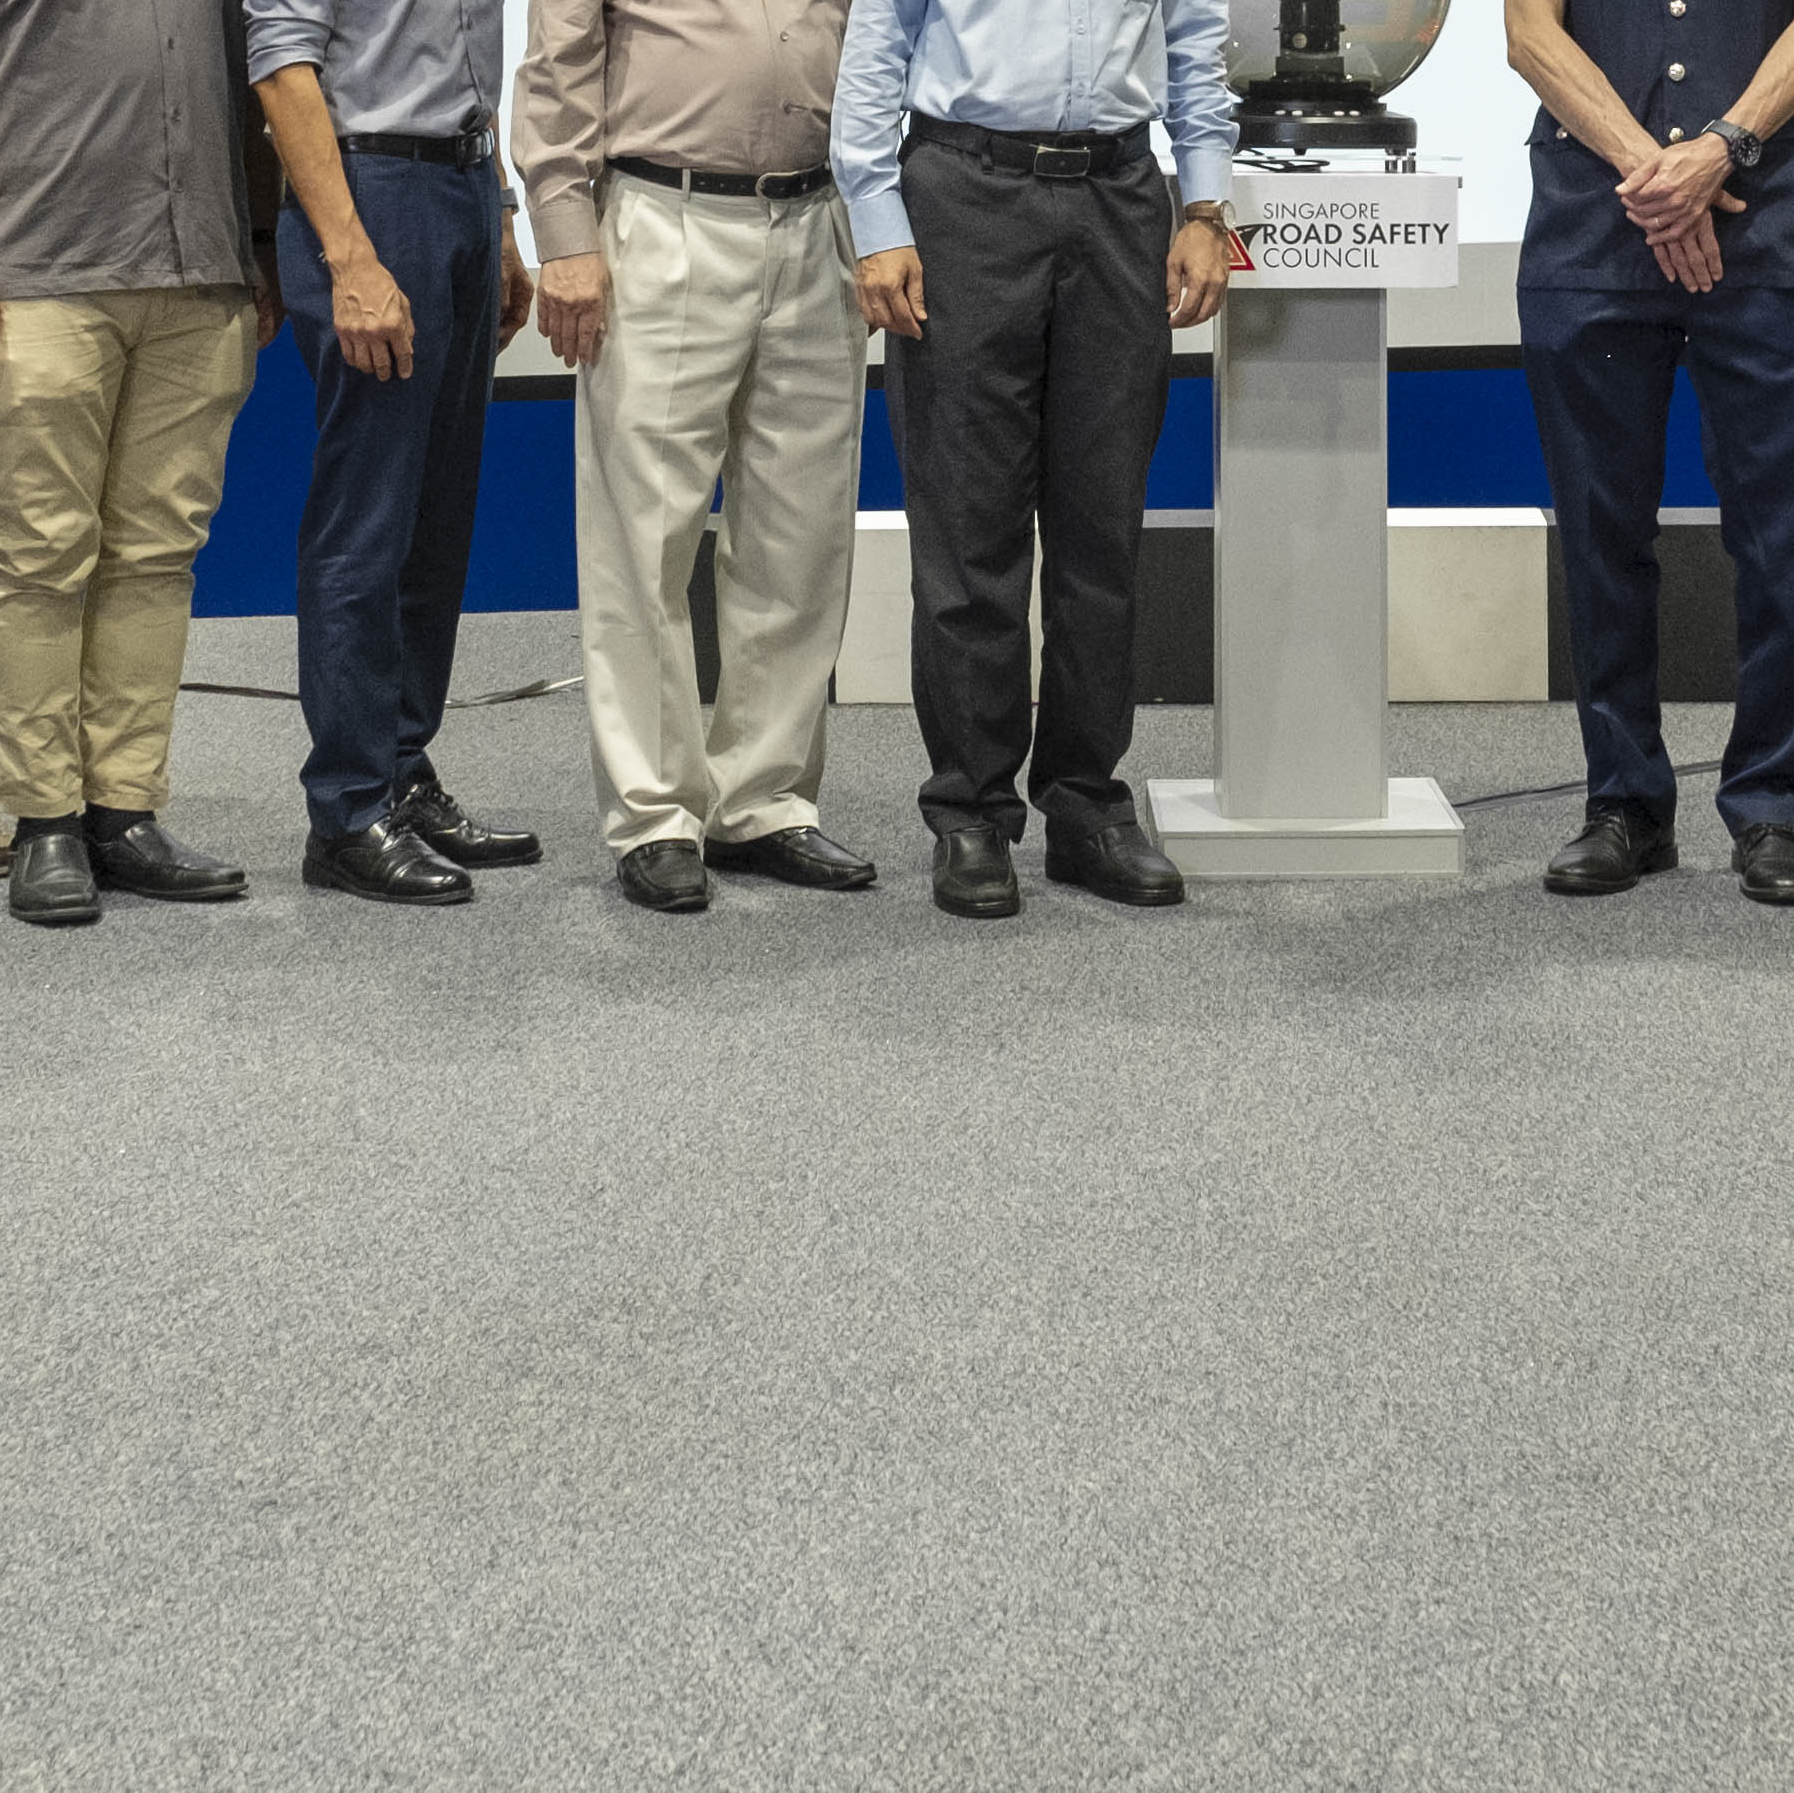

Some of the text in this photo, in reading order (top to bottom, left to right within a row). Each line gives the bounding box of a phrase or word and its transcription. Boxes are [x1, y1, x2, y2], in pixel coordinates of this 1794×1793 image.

[1263, 202, 1380, 220] SINGAPORE
[1262, 223, 1450, 245] ROAD SAFETY
[1263, 248, 1380, 268] COUNCIL
